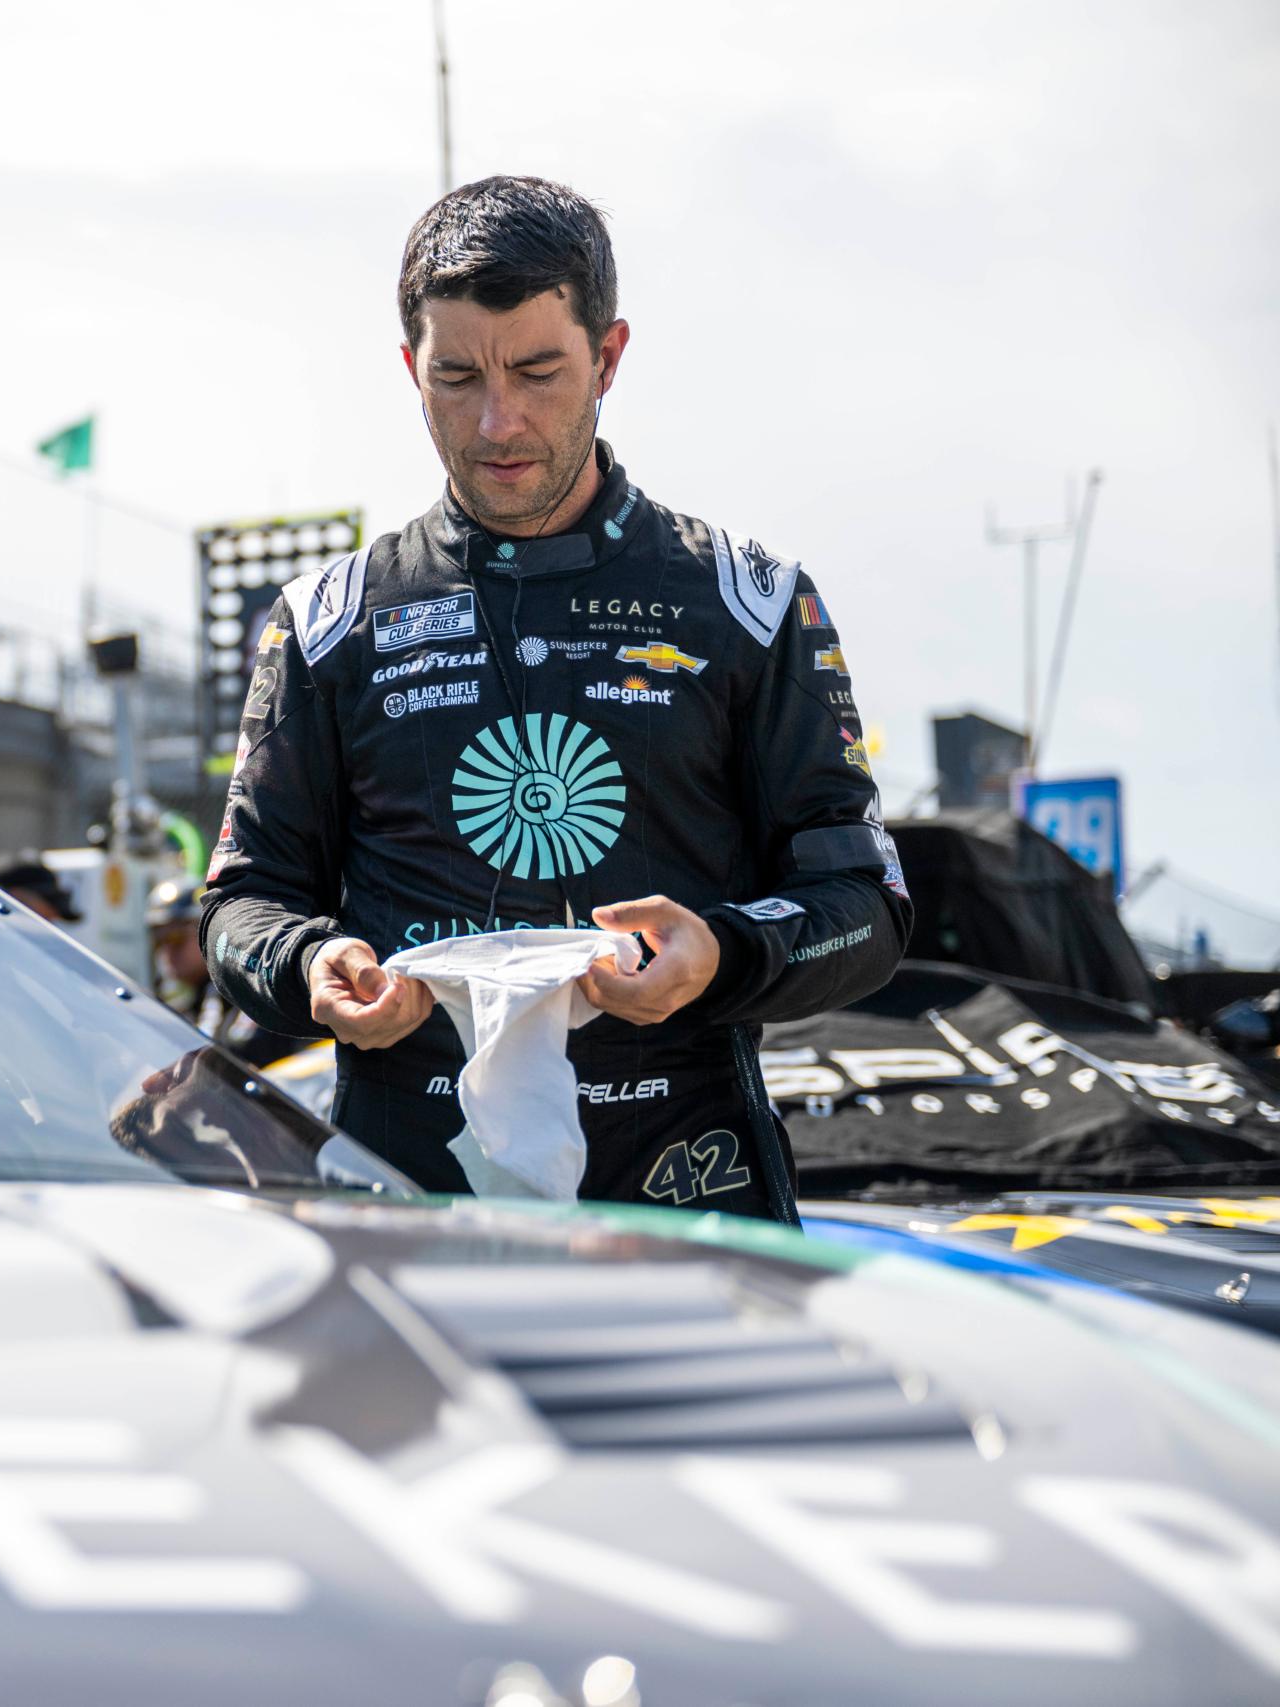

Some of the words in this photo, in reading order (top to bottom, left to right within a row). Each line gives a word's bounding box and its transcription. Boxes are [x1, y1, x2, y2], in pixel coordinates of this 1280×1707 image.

[405, 599, 459, 620] NASCAR
[571, 598, 684, 619] LEGACY
[388, 624, 414, 641] CUP
[414, 616, 461, 633] SERIES
[588, 622, 628, 632] MOTOR
[634, 625, 663, 635] CLUB
[549, 640, 608, 652] SUNSEEKER
[565, 651, 592, 660] RESORT
[407, 684, 444, 703] BLACK
[446, 680, 479, 697] RIFLE
[584, 681, 672, 705] allegiant
[408, 698, 438, 713] COFFEE
[439, 693, 479, 707] COMPANY
[642, 1128, 751, 1205] 42
